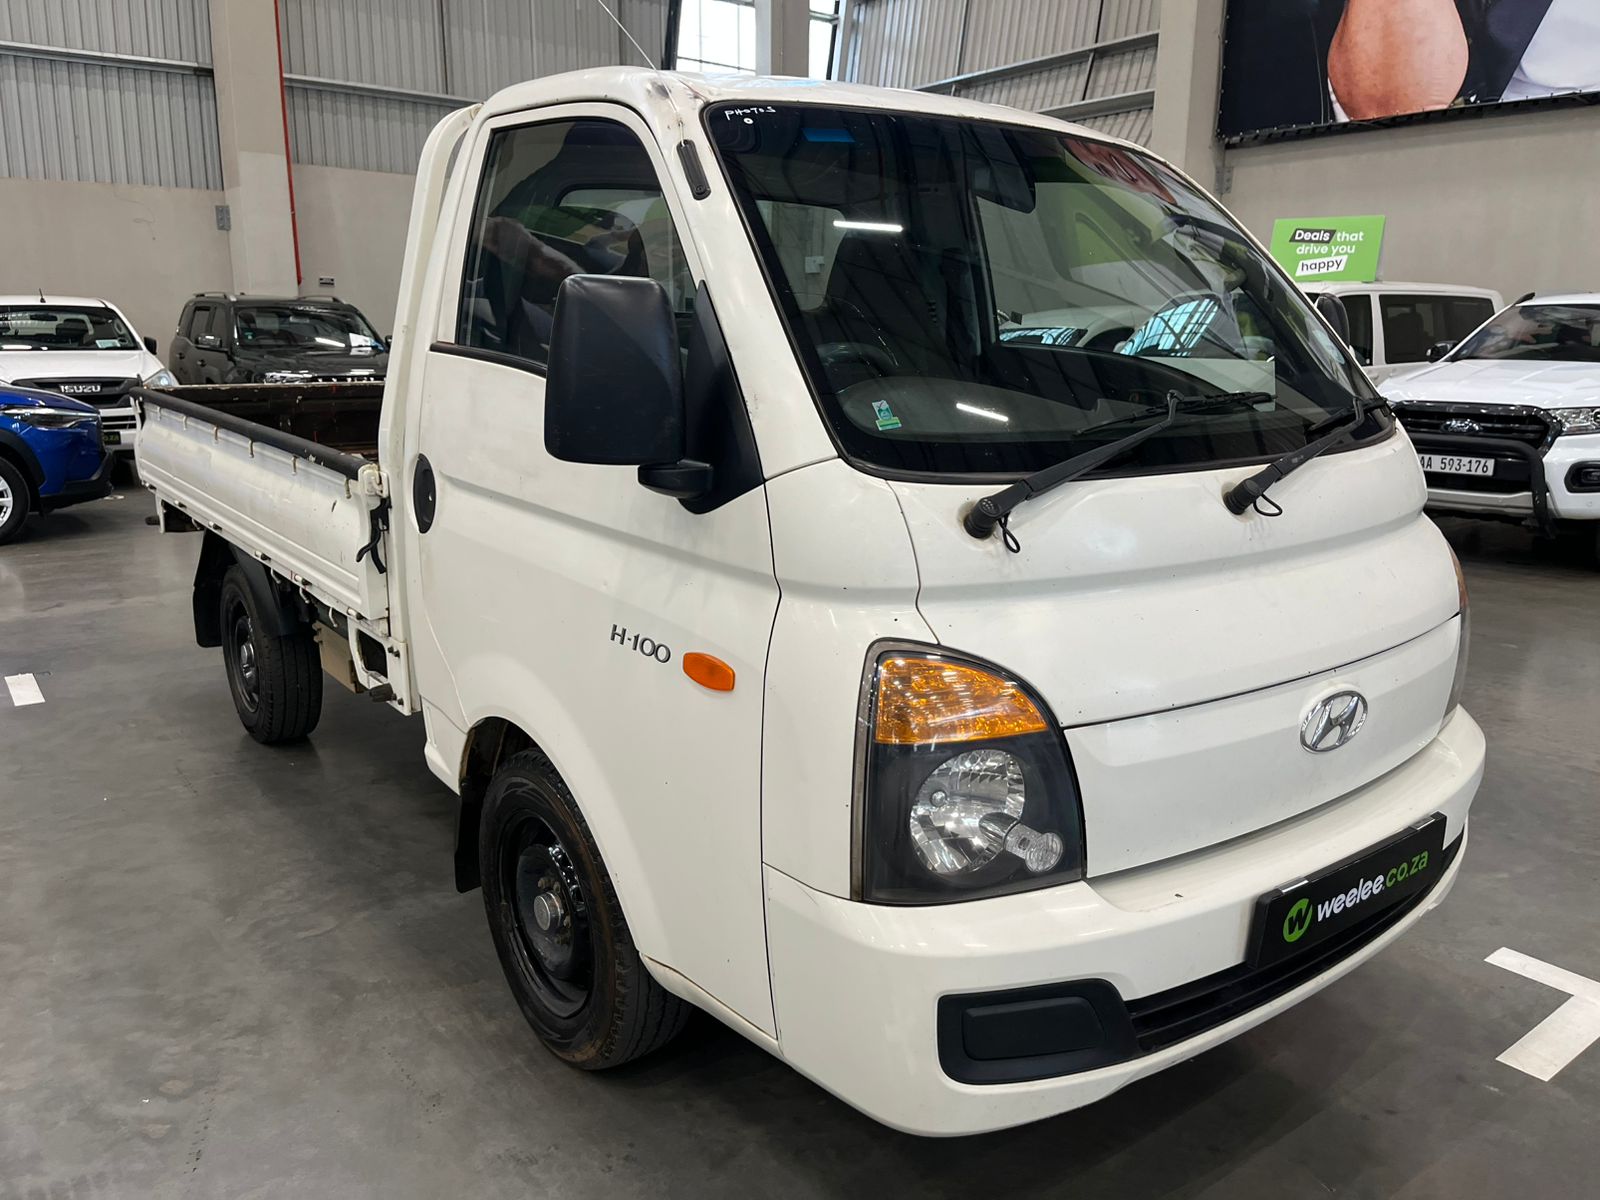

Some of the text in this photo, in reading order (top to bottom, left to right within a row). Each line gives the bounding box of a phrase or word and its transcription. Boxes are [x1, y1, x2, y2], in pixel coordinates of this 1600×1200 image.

[1294, 229, 1364, 242] Deals that
[1296, 243, 1355, 257] drive you
[1301, 258, 1343, 272] happy
[60, 385, 101, 393] ISUZU
[1440, 457, 1489, 474] 593-176
[610, 623, 671, 664] H-100
[1317, 850, 1429, 922] weelee.co.za
